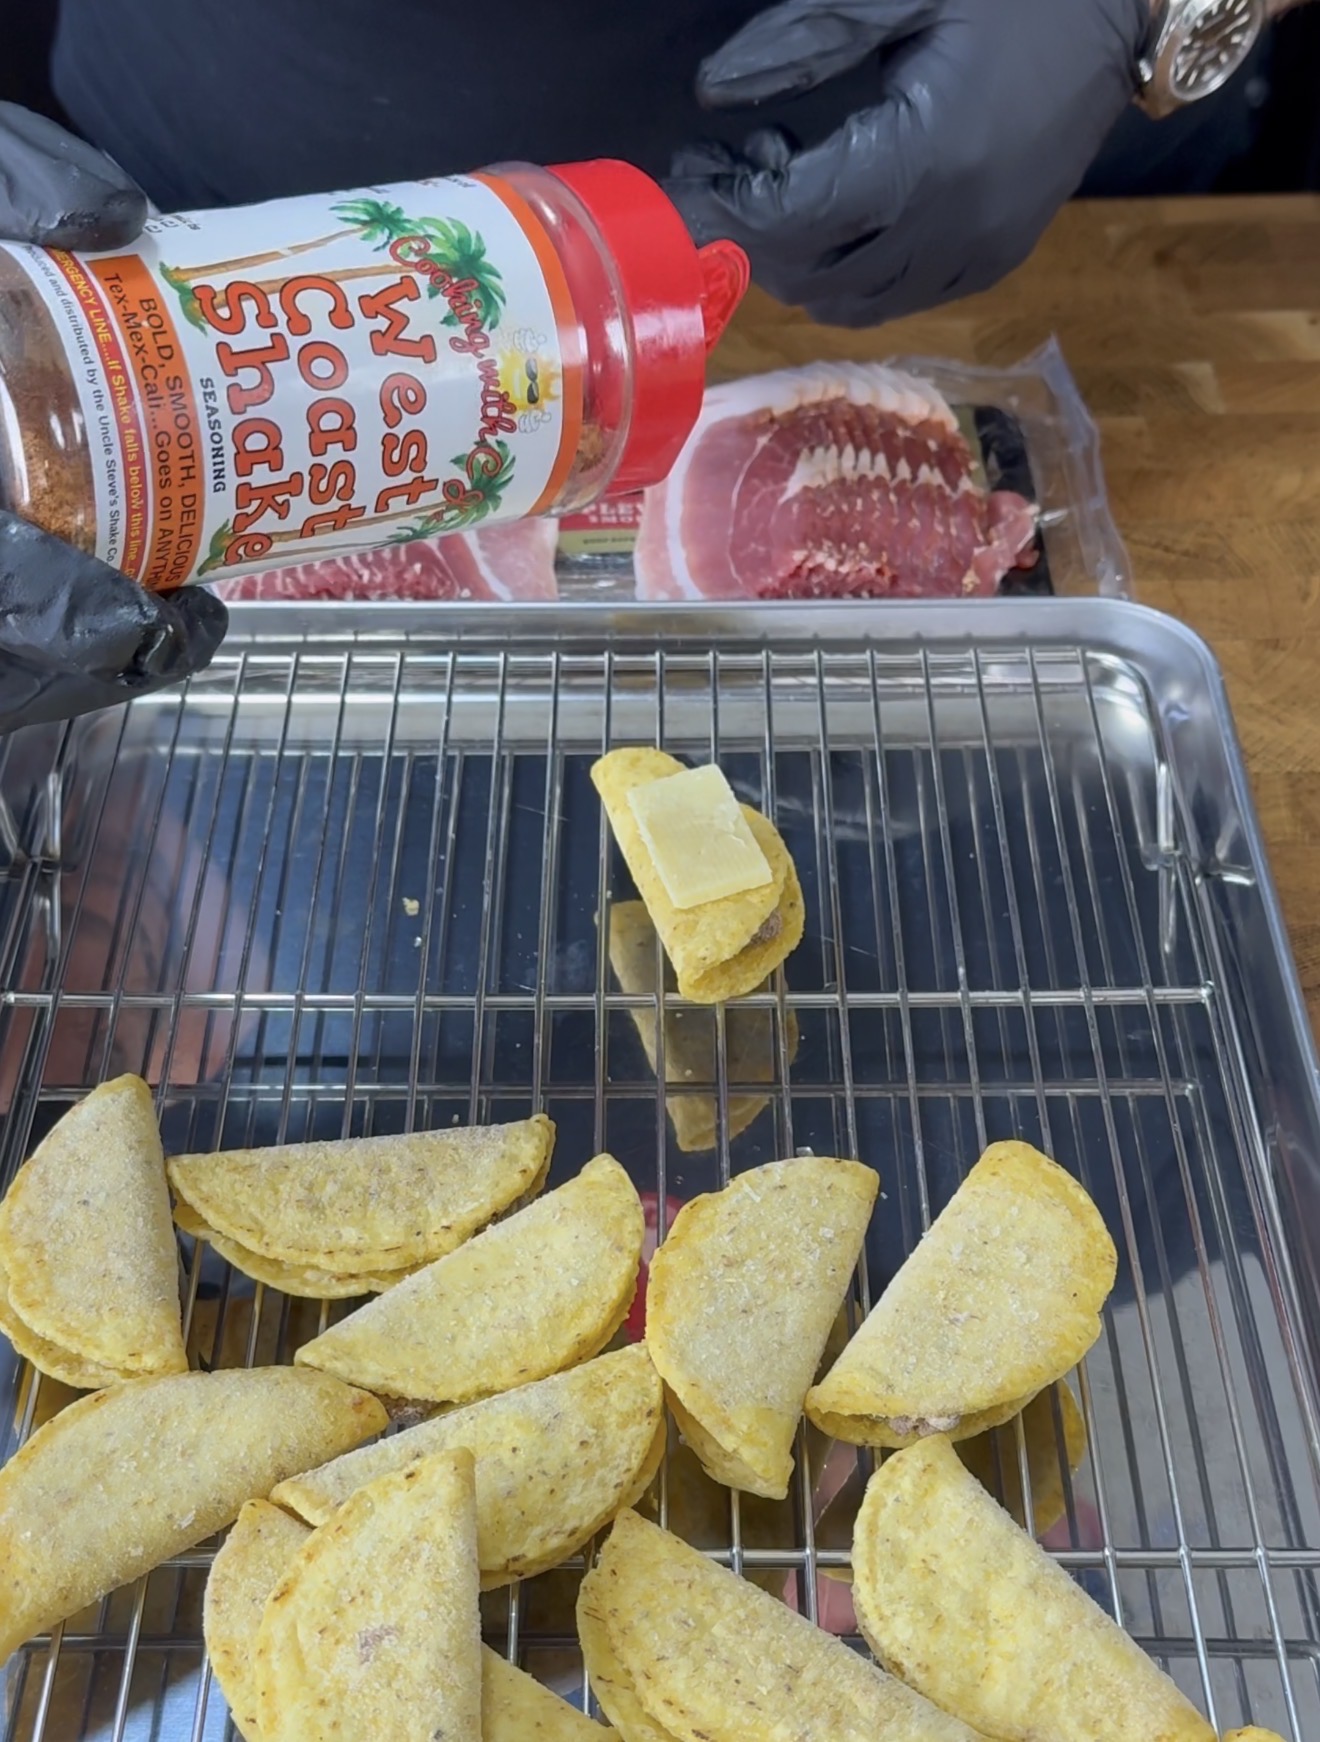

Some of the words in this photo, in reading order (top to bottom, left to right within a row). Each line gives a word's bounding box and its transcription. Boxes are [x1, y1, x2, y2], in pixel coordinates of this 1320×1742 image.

[49, 278, 67, 297] and
[61, 296, 94, 364] distributed
[139, 298, 175, 369] BOLD,
[389, 236, 490, 359] Cooking
[478, 359, 517, 441] with
[86, 367, 98, 386] by
[93, 389, 105, 412] the
[112, 374, 131, 424] Shake
[358, 275, 439, 513] West
[192, 280, 304, 566] Shake
[279, 275, 366, 538] Coast
[98, 415, 113, 455] Uncle
[124, 428, 139, 462] falls
[166, 376, 196, 488] SMOOTH,
[200, 377, 227, 493] SEASONING
[106, 459, 118, 507] Steve's
[129, 466, 143, 510] below
[109, 509, 121, 545] Shake
[130, 512, 143, 537] this
[160, 496, 173, 521] on
[165, 493, 197, 583] DELICIOUS
